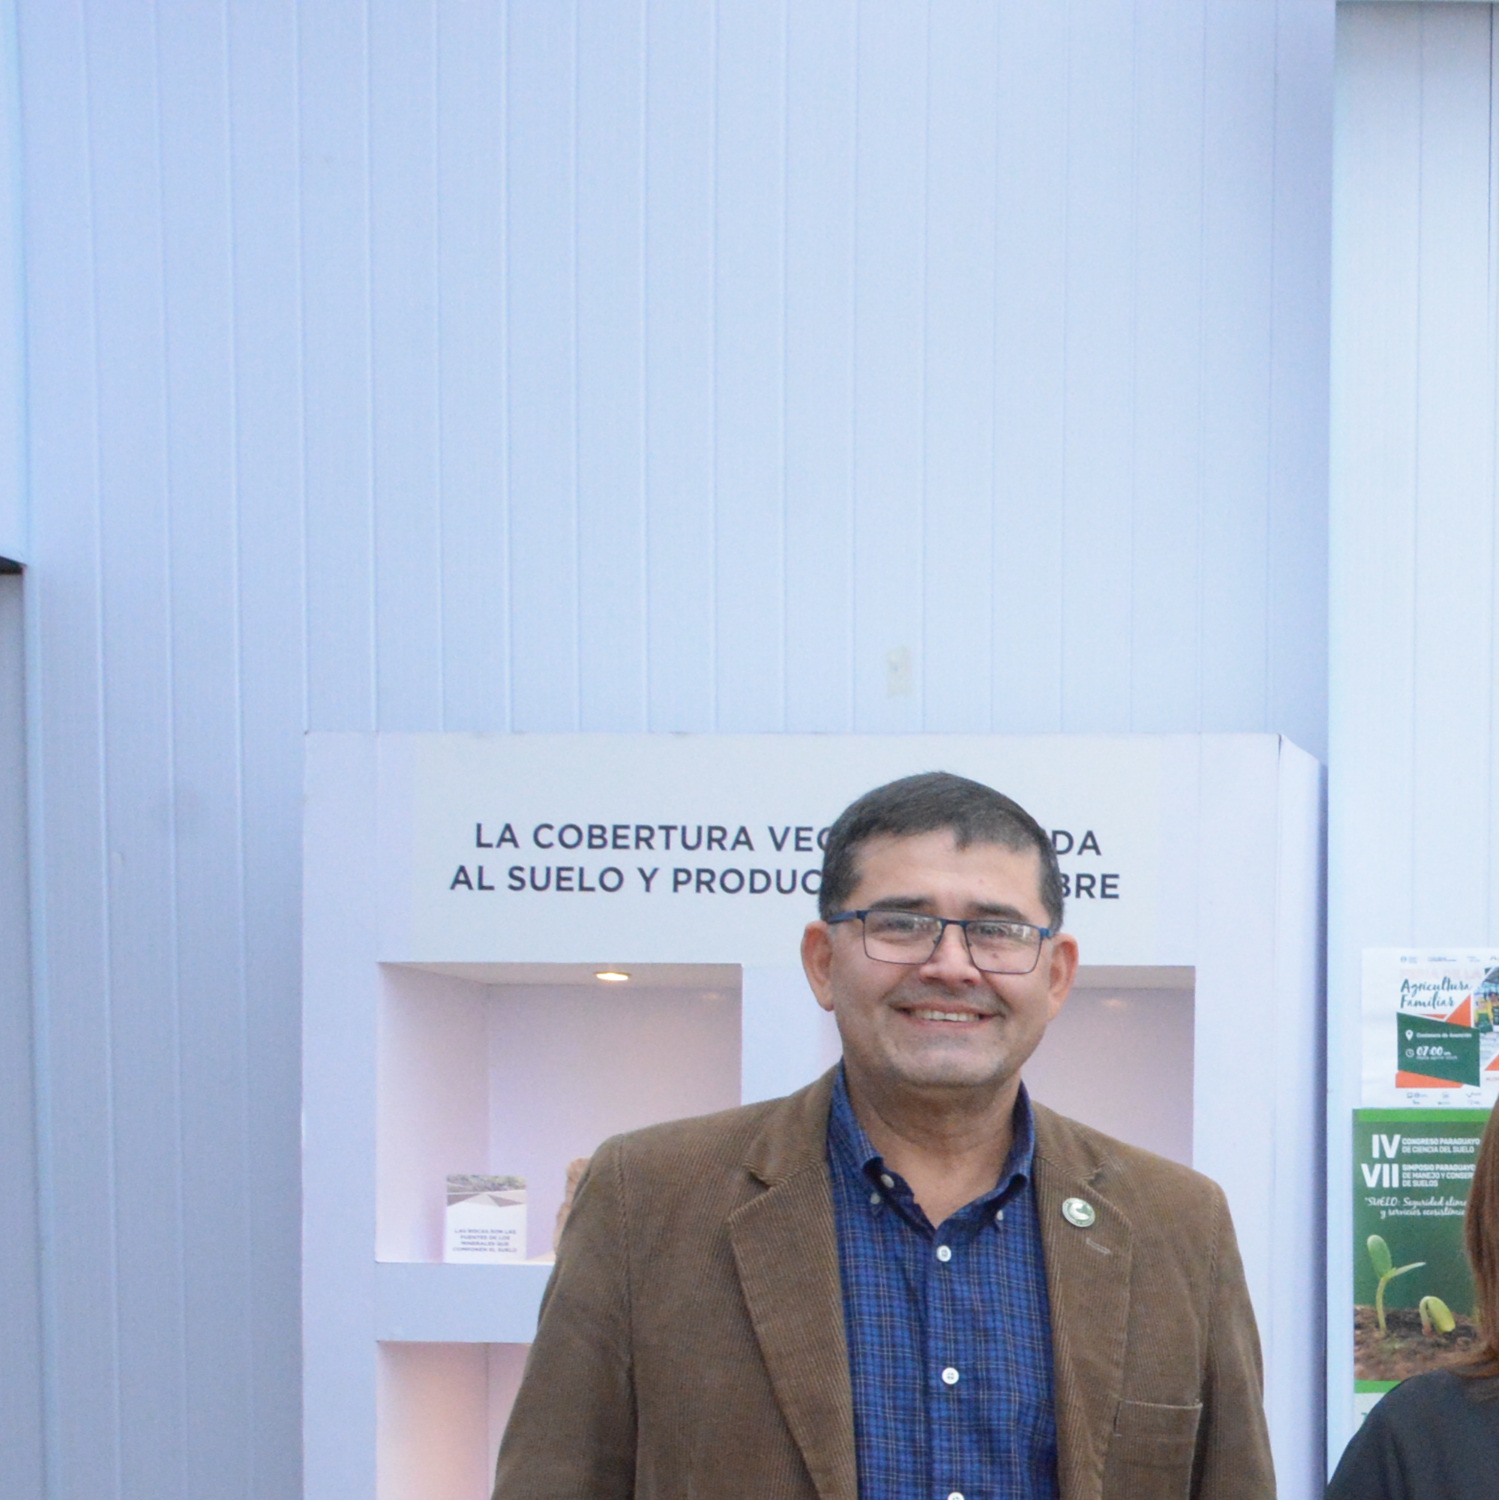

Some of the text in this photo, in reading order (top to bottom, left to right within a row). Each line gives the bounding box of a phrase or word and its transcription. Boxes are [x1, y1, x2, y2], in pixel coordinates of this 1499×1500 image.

[475, 822, 520, 849] LA
[533, 823, 755, 851] COBERTURA
[449, 865, 495, 891] AL
[507, 866, 625, 893] SUELO
[637, 867, 659, 893] Y
[1400, 976, 1472, 998] Agricultura
[1400, 991, 1455, 1010] Familiar
[1371, 1134, 1401, 1159] IV
[1401, 1145, 1475, 1154] DE CIENCIA DEL SUELO
[1360, 1163, 1400, 1189] VII
[1401, 1163, 1435, 1171] SIMPOSIO
[1401, 1171, 1411, 1179] DE
